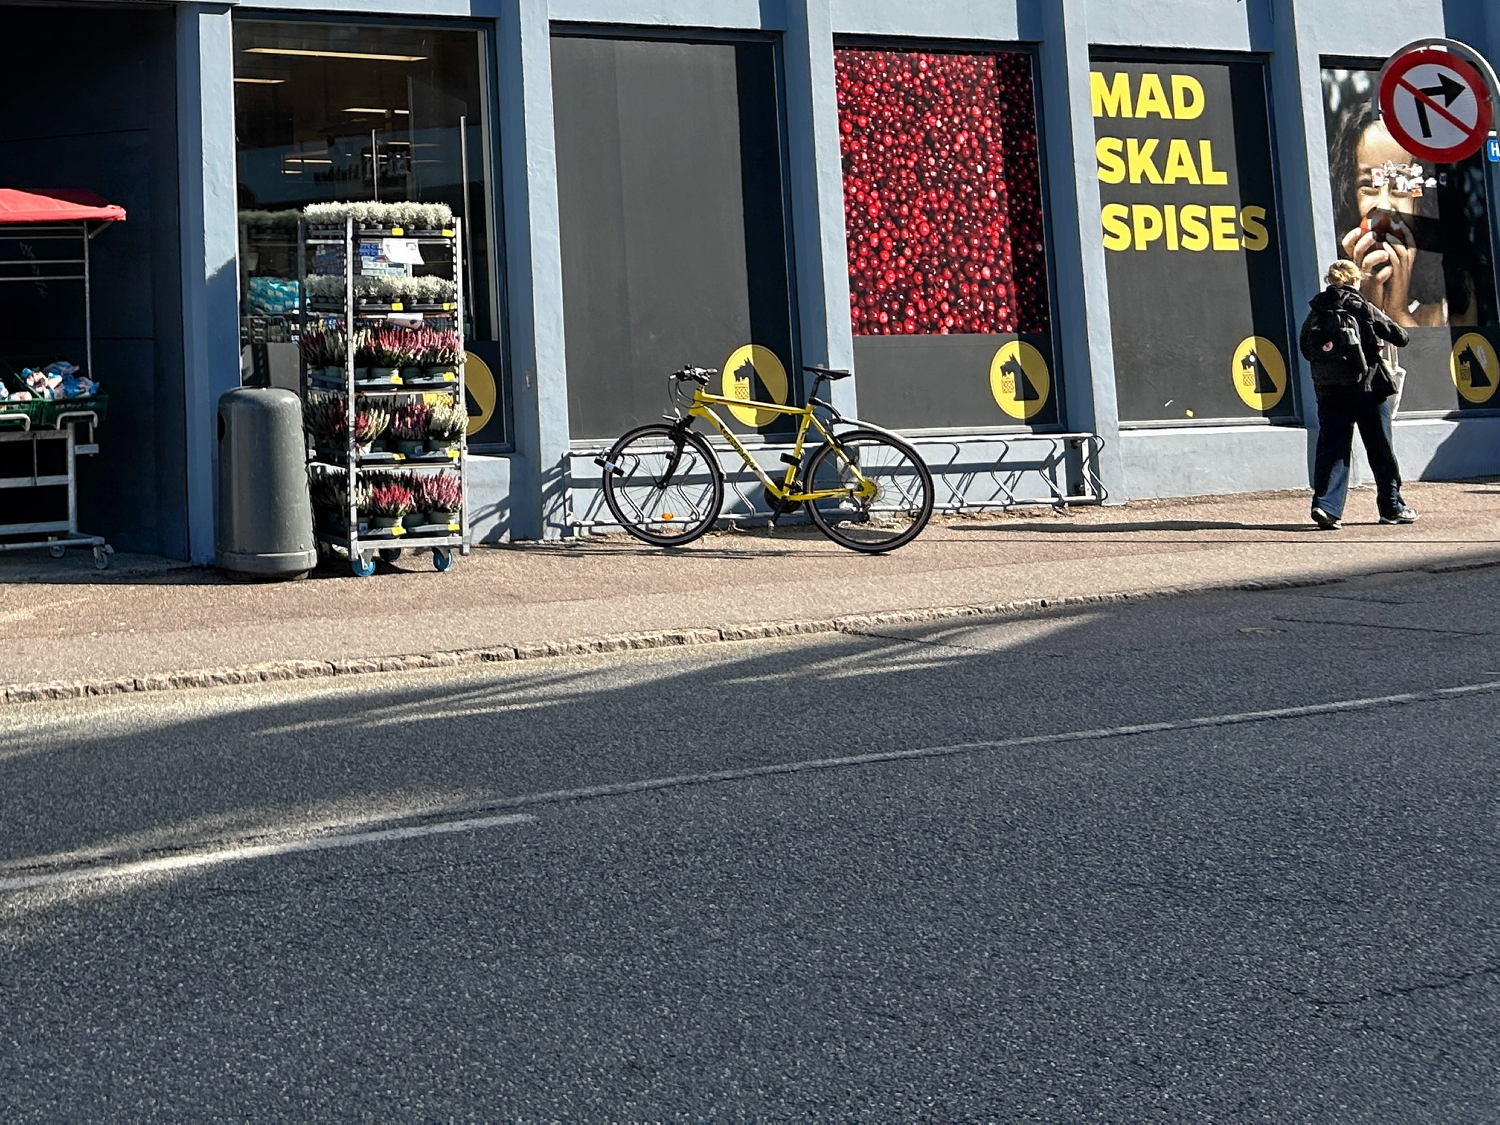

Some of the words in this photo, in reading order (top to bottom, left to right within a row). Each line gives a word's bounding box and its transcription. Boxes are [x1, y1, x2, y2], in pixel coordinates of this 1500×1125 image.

[1089, 71, 1205, 120] MAD
[1095, 136, 1228, 185] SKAL
[1101, 203, 1269, 252] SPISES
